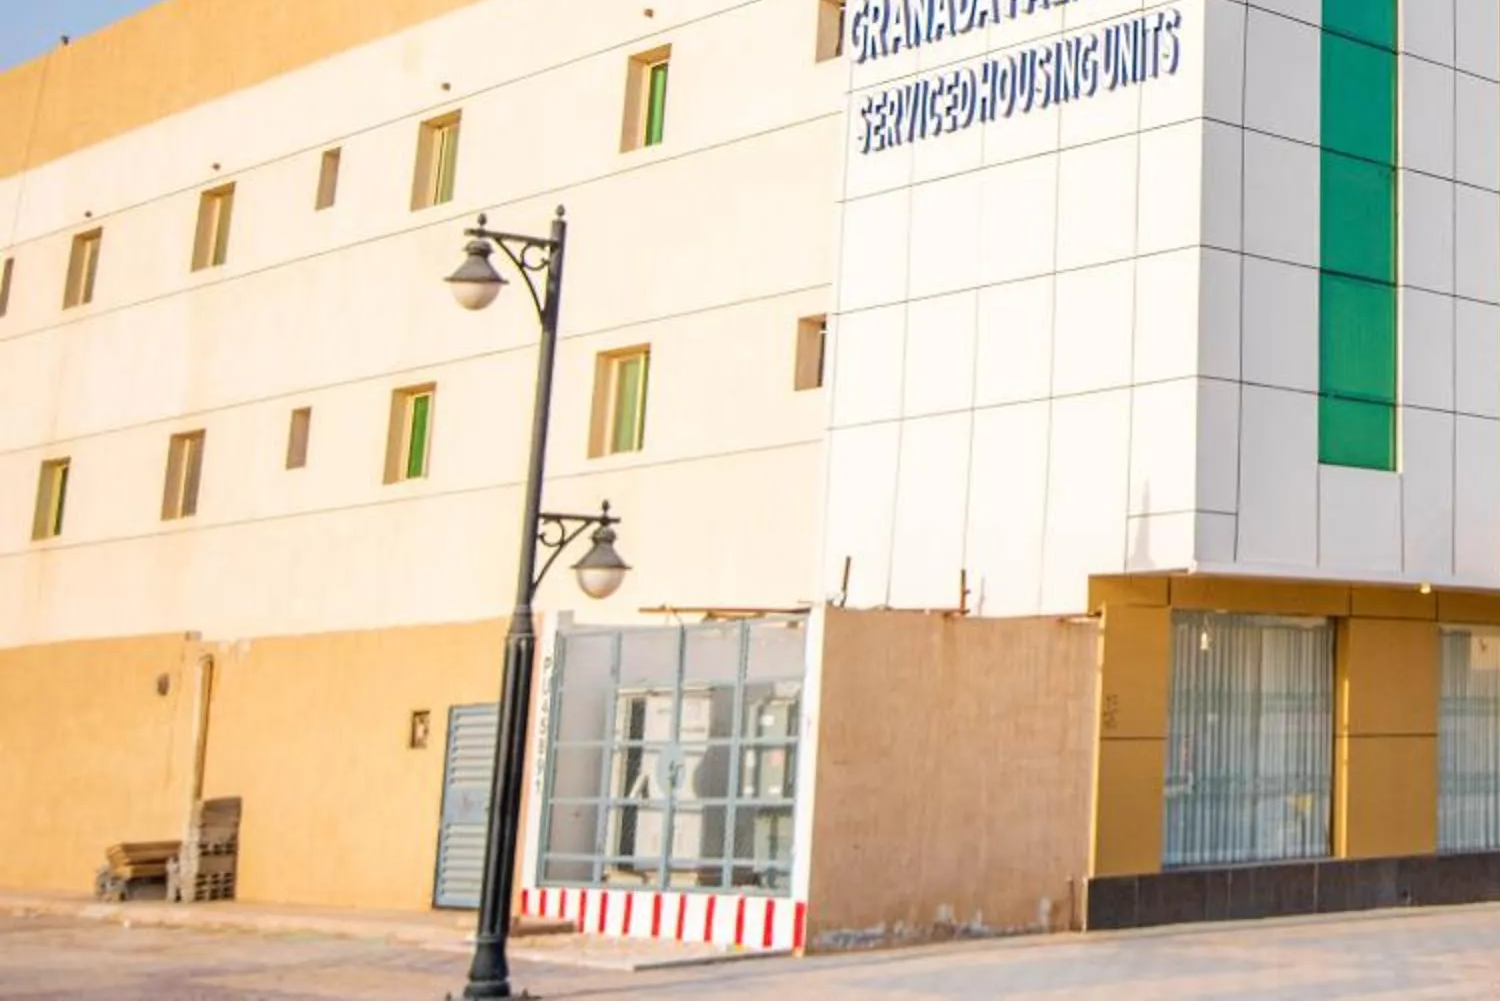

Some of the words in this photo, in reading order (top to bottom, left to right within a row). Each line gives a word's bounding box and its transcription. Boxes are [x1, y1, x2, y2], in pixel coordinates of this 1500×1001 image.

[857, 67, 977, 156] SERVICED
[978, 32, 1100, 124] HOUSING
[1103, 7, 1182, 92] UNITS
